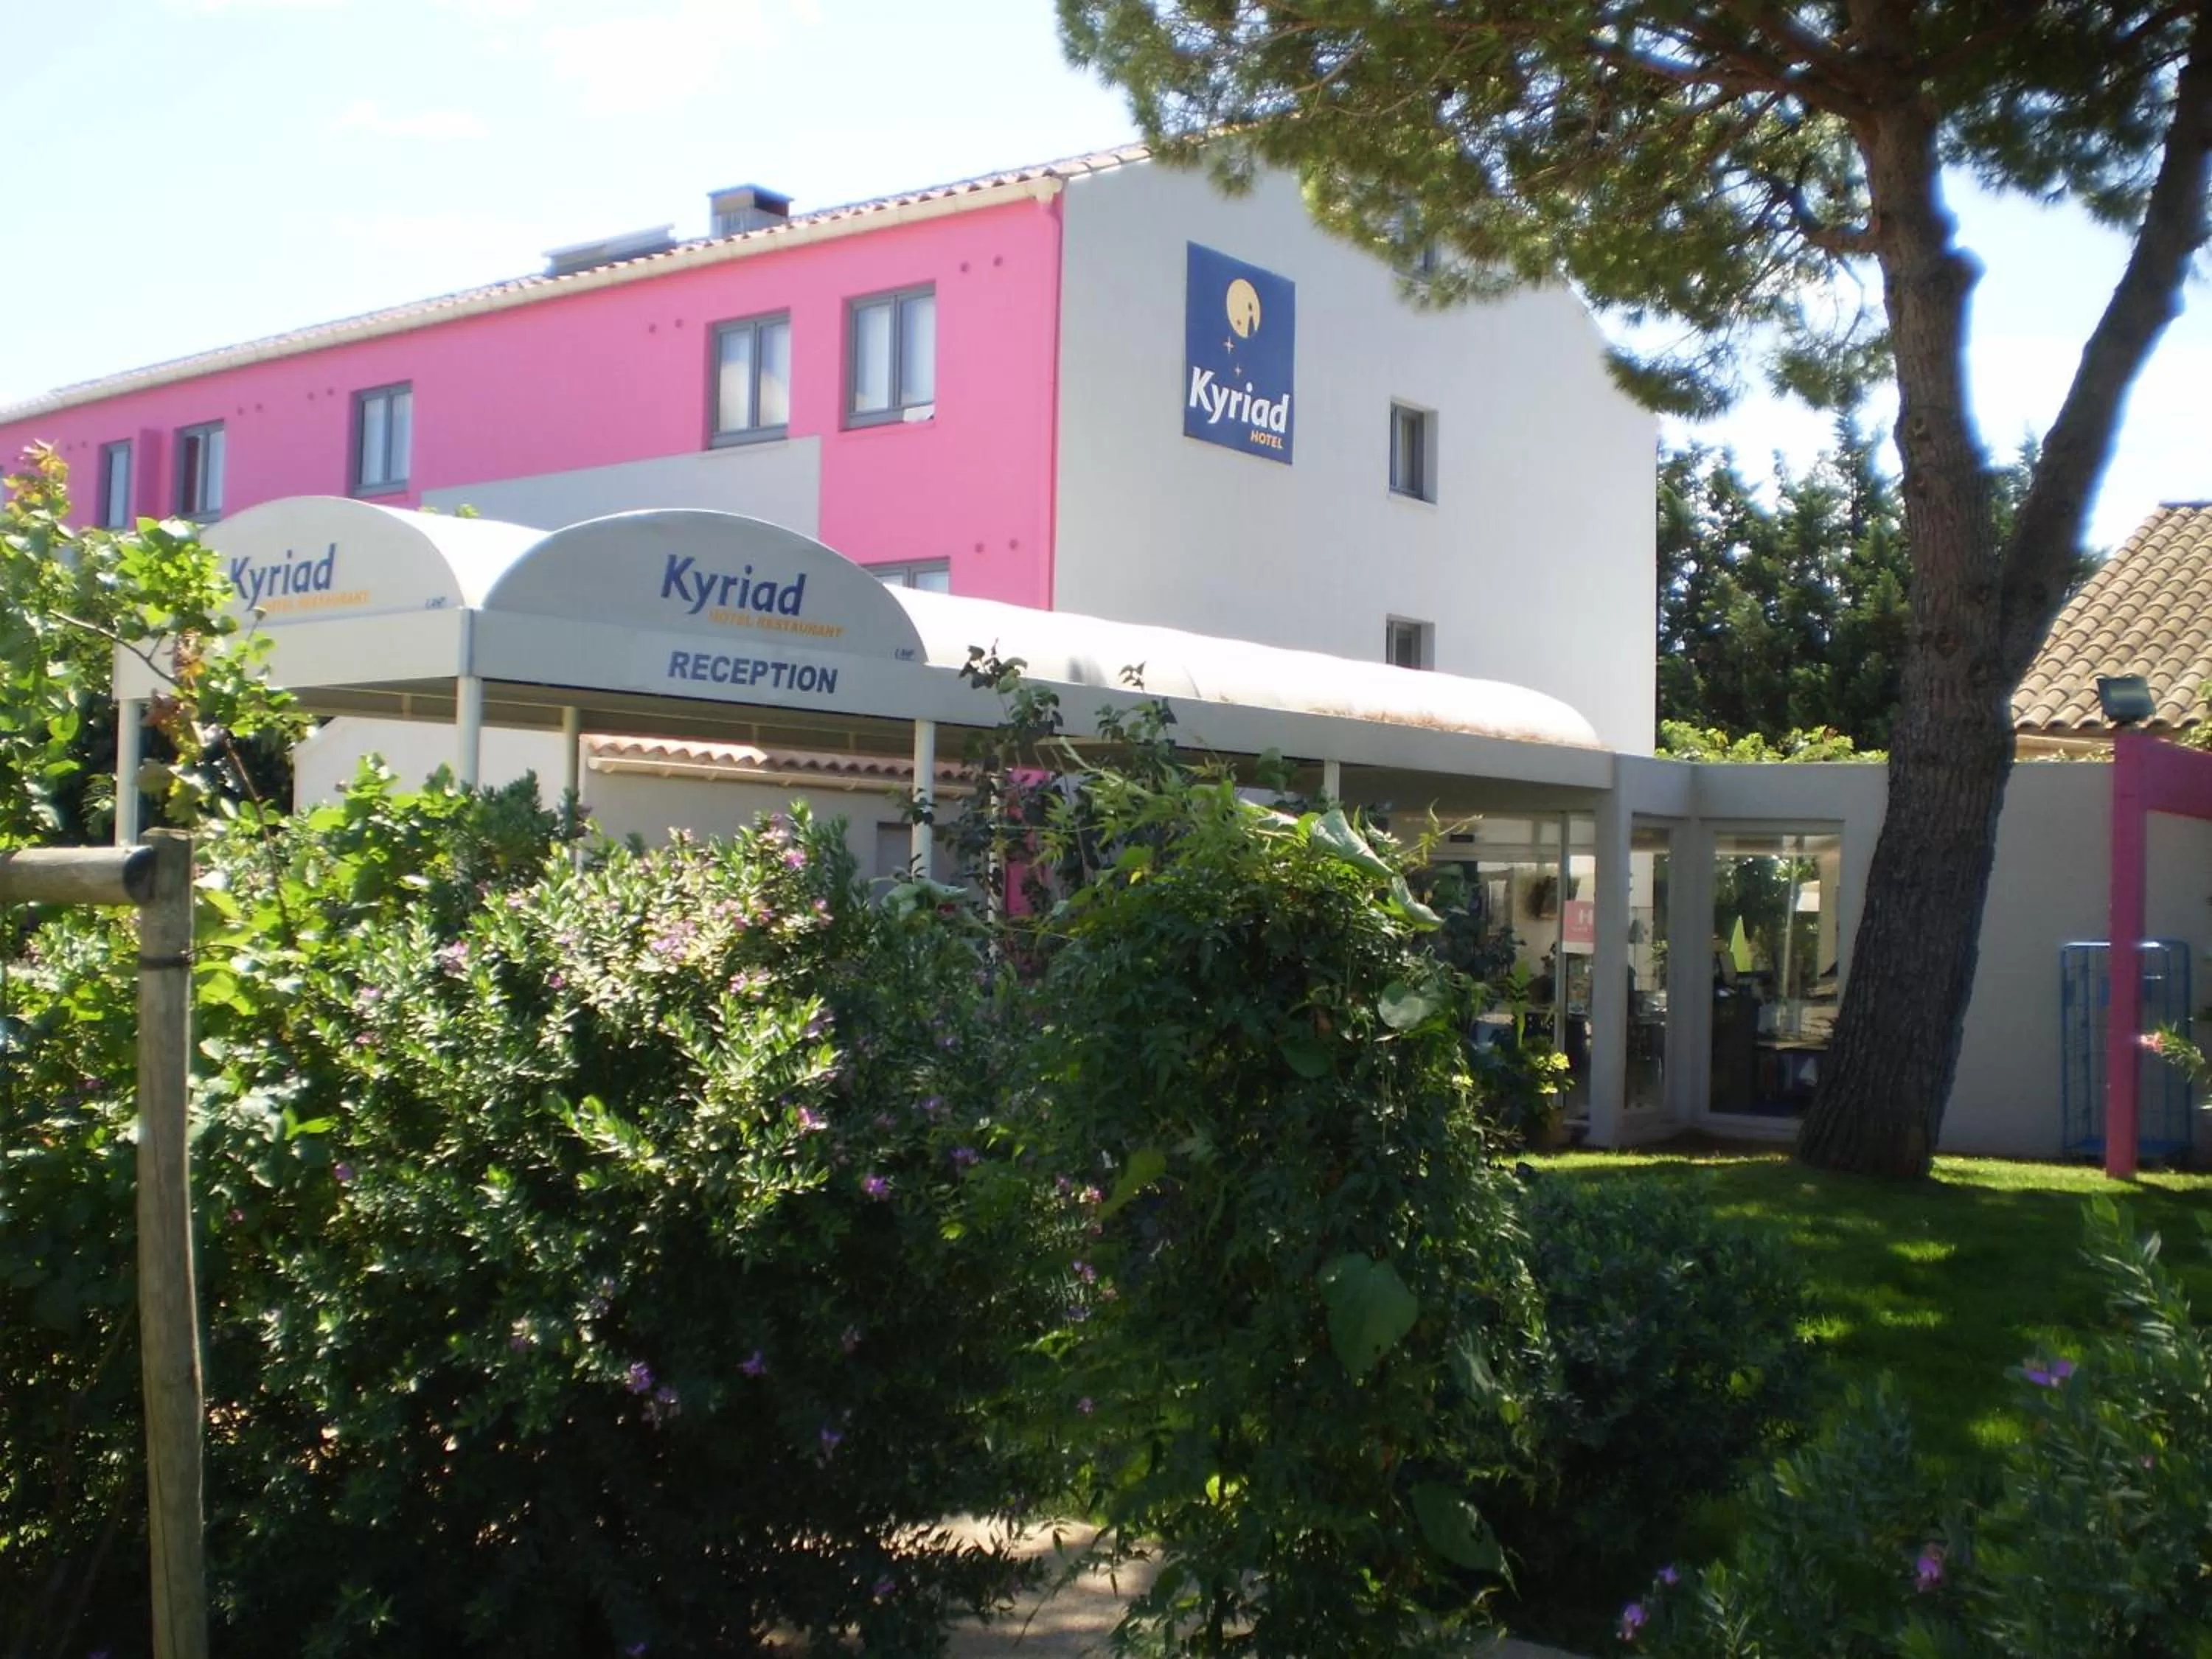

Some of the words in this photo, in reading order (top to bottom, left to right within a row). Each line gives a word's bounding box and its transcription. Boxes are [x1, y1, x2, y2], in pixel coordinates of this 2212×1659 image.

[1189, 366, 1290, 433] Kyriad
[1251, 430, 1284, 449] HOTEL
[230, 543, 335, 611] Kyriad
[660, 554, 807, 615] Kyriad
[669, 651, 838, 694] RECEPTION
